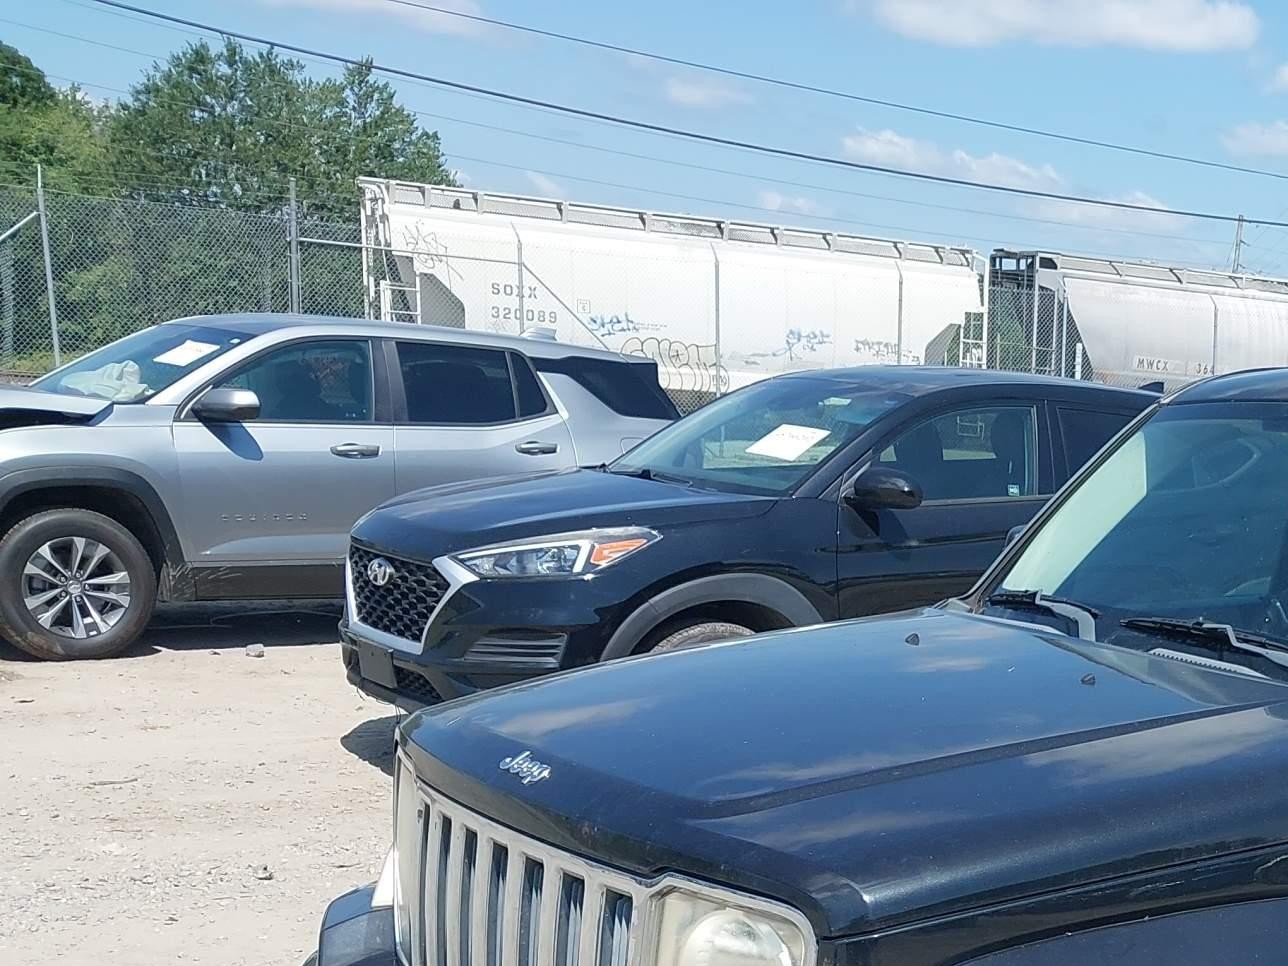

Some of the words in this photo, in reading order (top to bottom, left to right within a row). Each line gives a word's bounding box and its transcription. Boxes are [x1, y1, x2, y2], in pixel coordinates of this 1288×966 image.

[491, 282, 538, 299] SOXX
[491, 306, 557, 323] 320089
[1136, 358, 1169, 371] MWCX
[500, 751, 551, 784] Jeep
